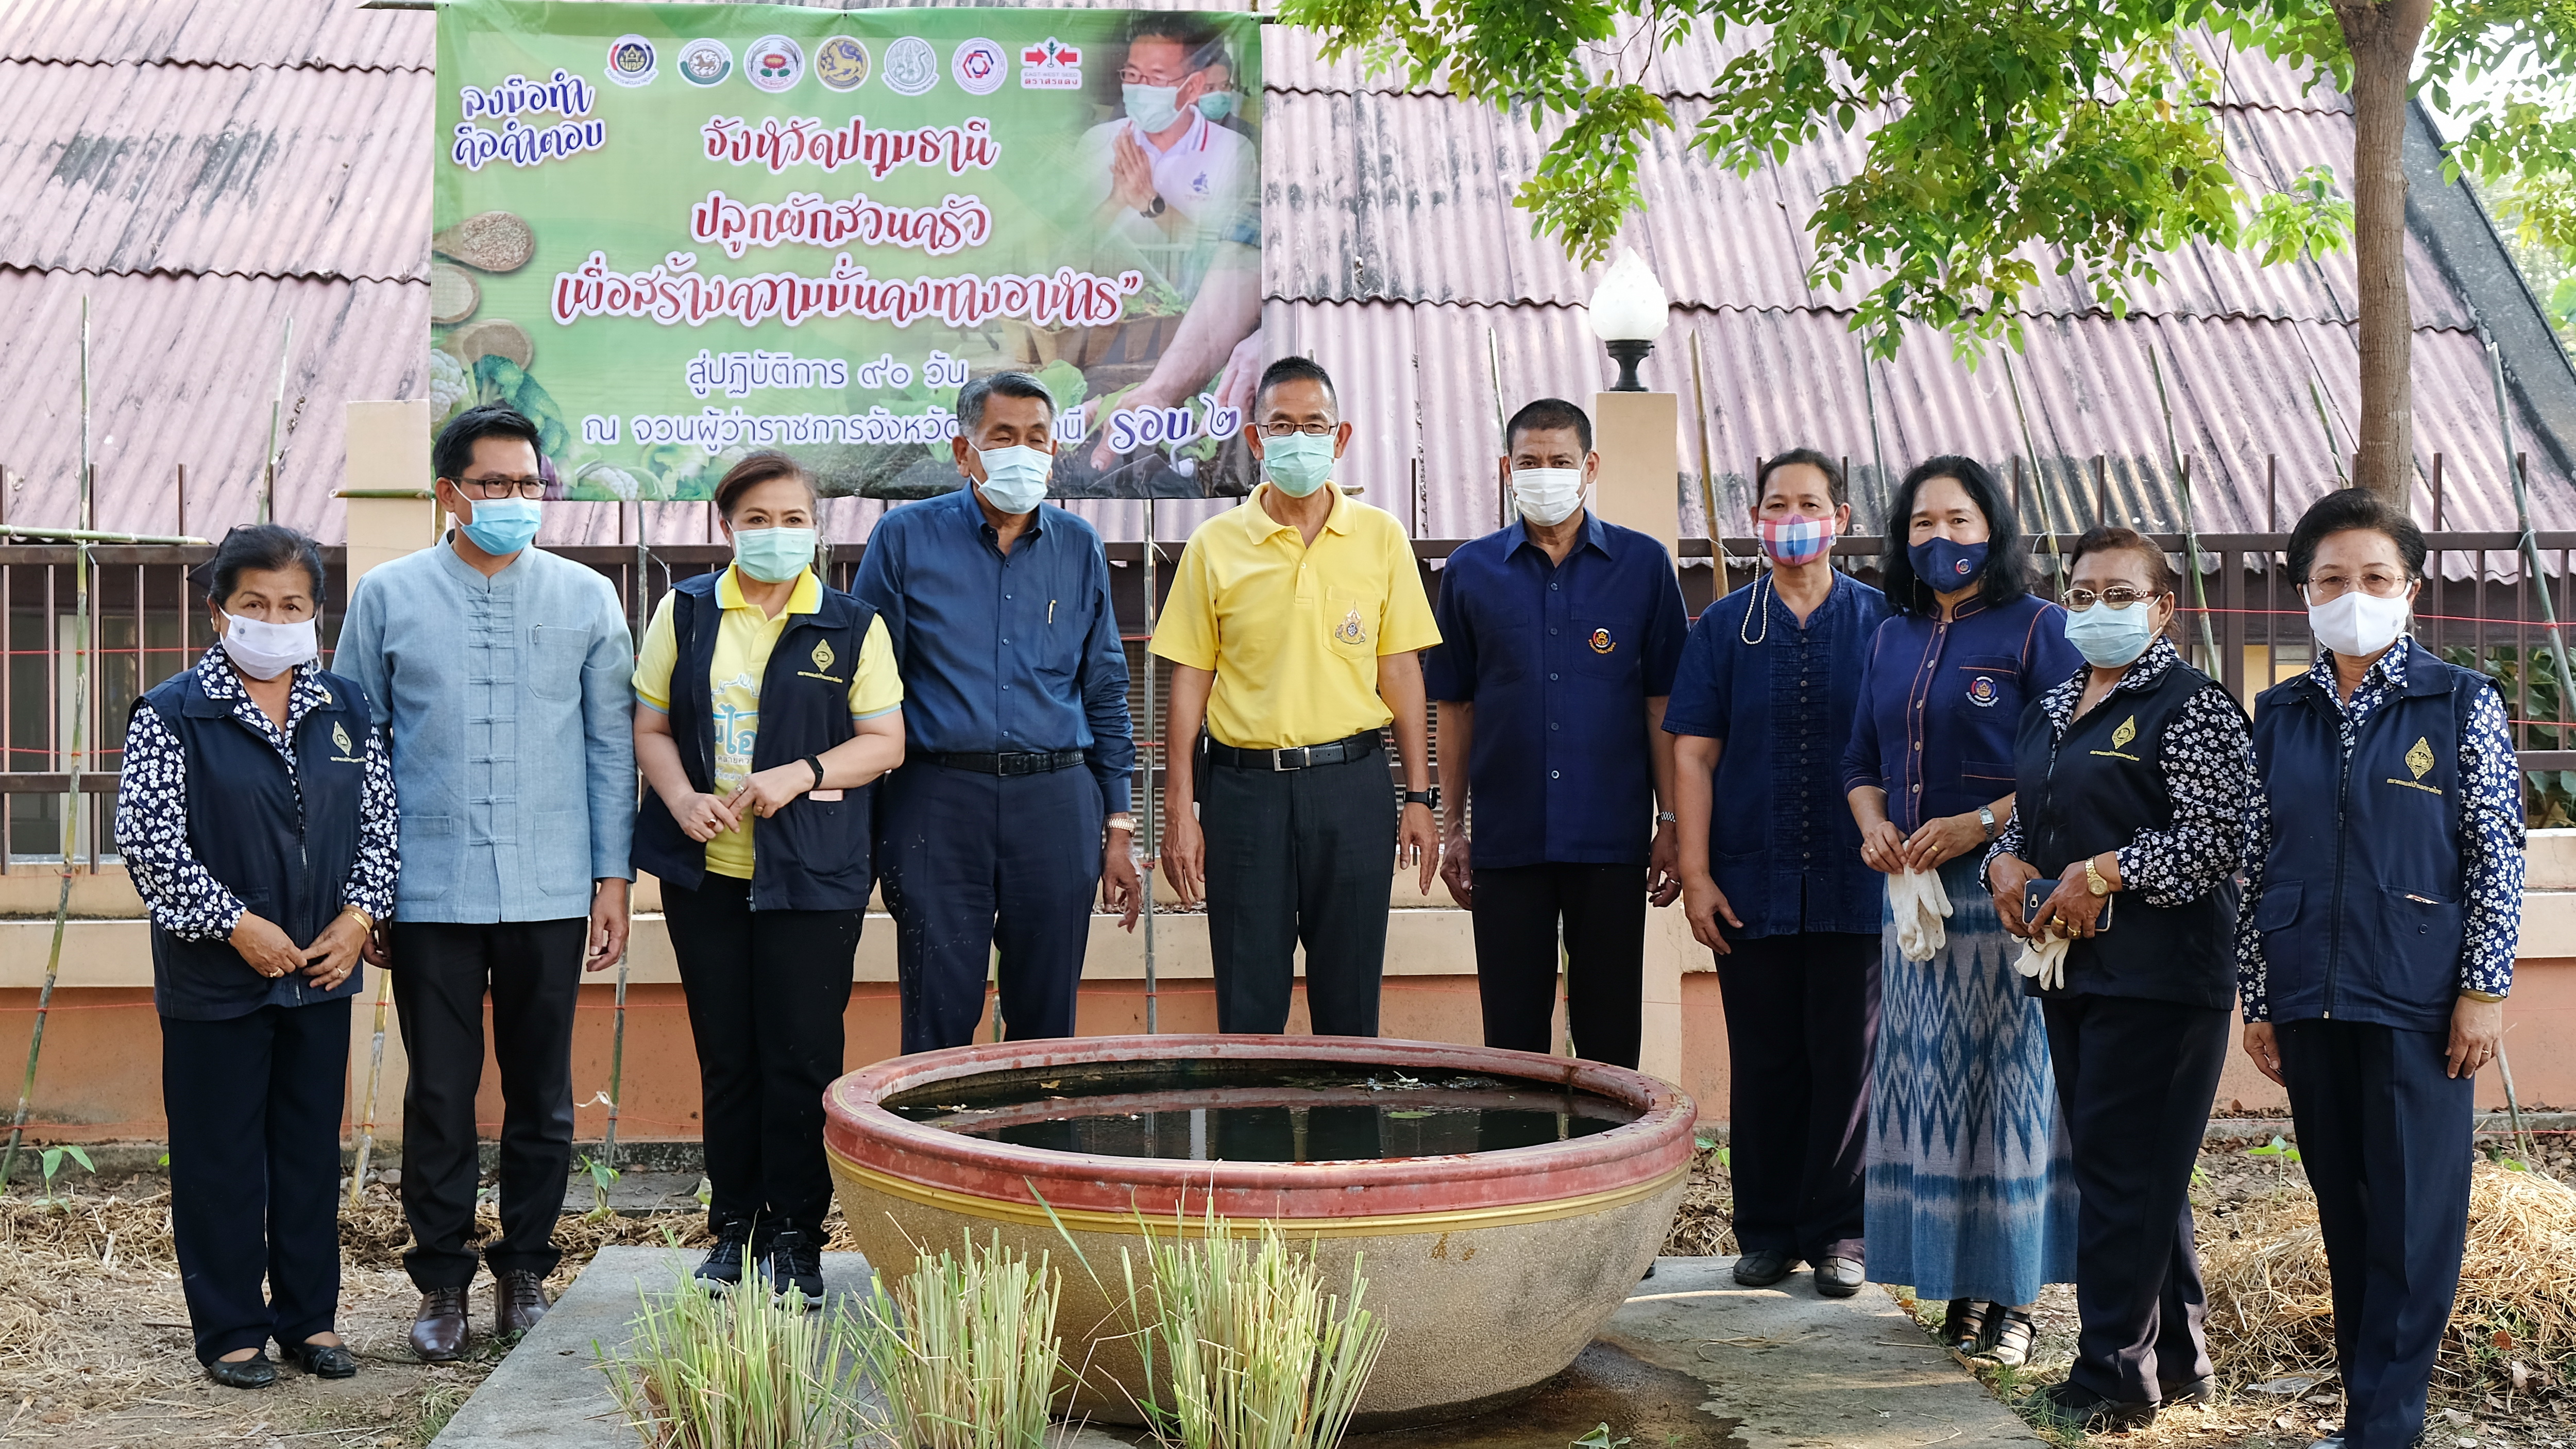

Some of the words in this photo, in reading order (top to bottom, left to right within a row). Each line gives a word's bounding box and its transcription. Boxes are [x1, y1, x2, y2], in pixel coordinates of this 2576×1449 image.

[466, 72, 593, 117] ลงมือทำ
[455, 121, 603, 167] คือคำตอบ
[704, 120, 997, 178] จังหวัดปทุมธานี
[696, 196, 987, 254] ปลูกผักสวนครัว
[689, 353, 845, 395] สู่ปฏิบัติการ
[862, 358, 909, 385] ๙๐
[926, 355, 966, 385] วัน
[586, 419, 616, 441] ณ
[1112, 410, 1189, 450] รอบ
[1204, 397, 1239, 437] ๒
